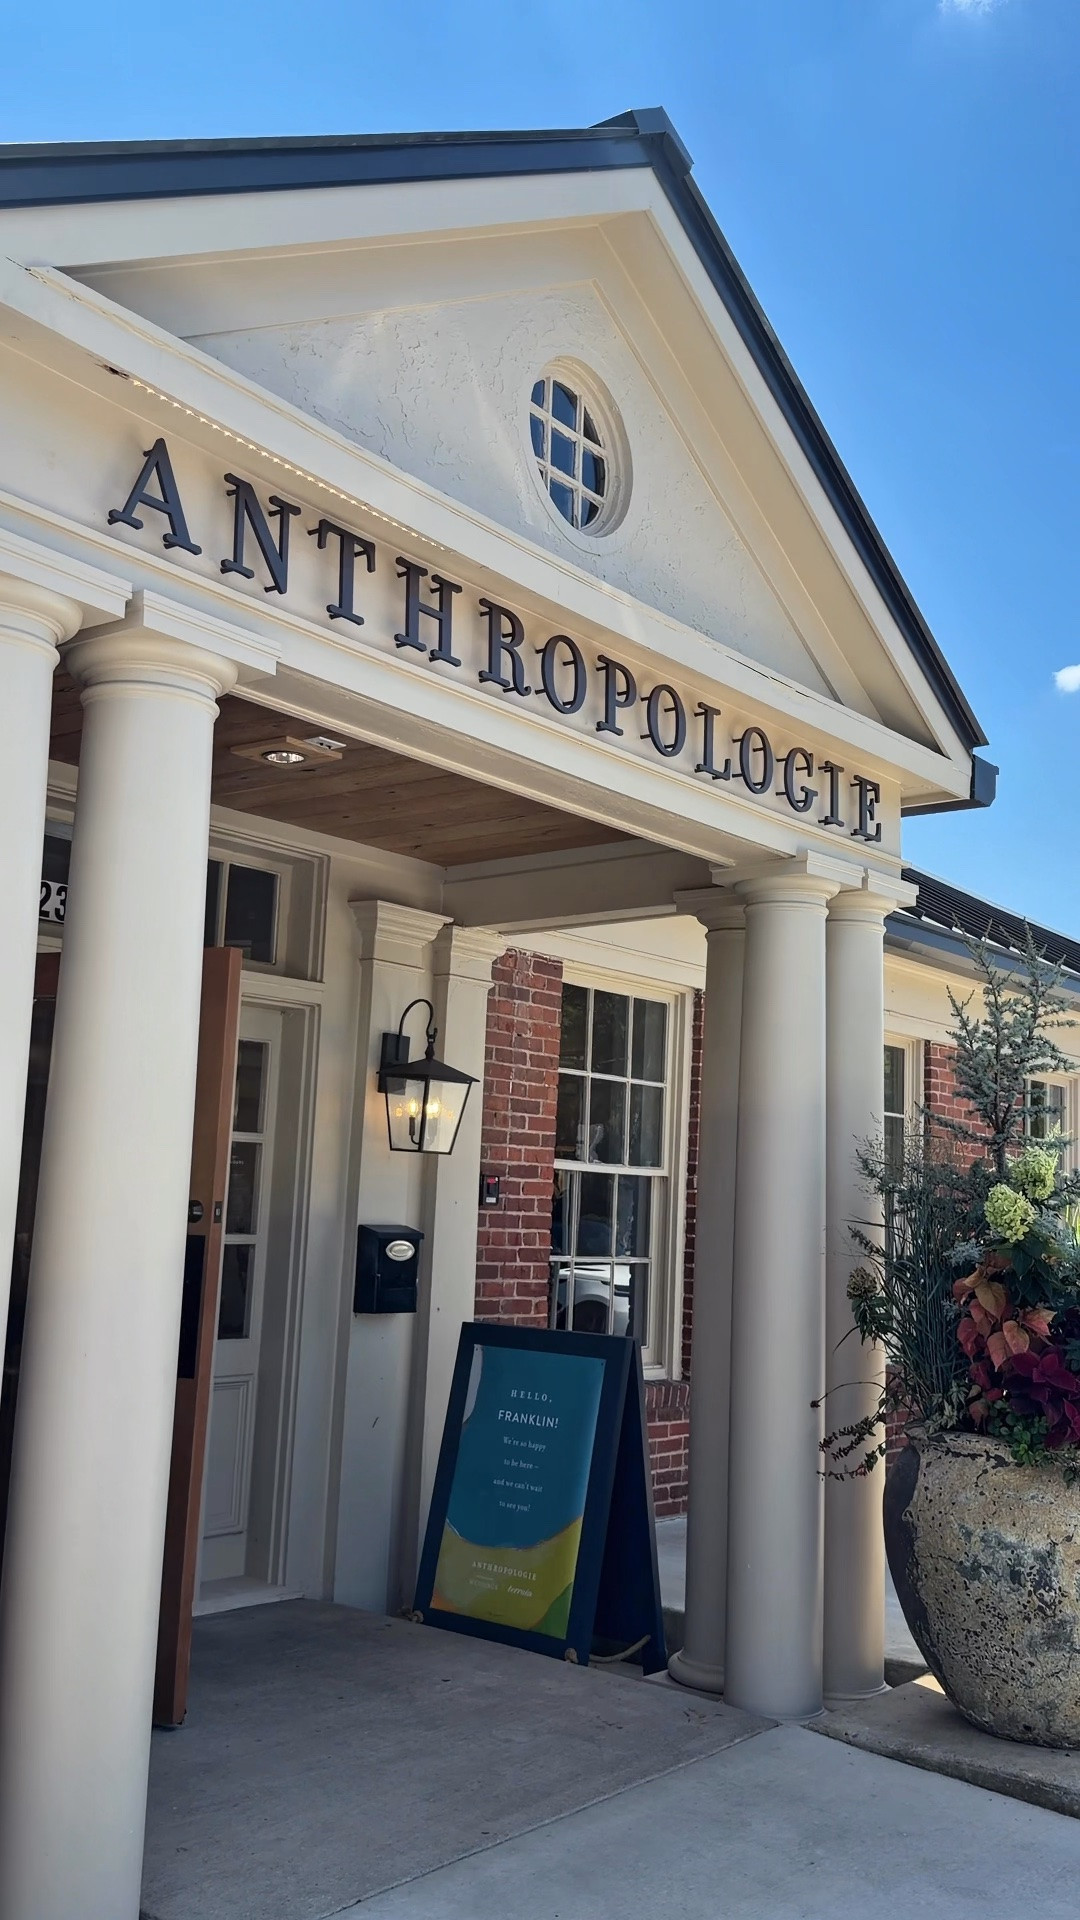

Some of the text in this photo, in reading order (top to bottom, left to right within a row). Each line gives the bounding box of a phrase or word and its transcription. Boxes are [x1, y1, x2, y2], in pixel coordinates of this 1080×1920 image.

[107, 438, 882, 842] ANTHROPOLOGIE
[511, 1389, 552, 1403] HELLO,
[498, 1409, 559, 1429] FRANKLIN!
[503, 1436, 519, 1446] We're
[528, 1440, 546, 1452] happy
[511, 1458, 519, 1467] be
[519, 1459, 533, 1469] here
[493, 1478, 505, 1486] and
[514, 1481, 529, 1490] can't
[530, 1484, 543, 1493] wait
[506, 1502, 516, 1510] see
[472, 1560, 536, 1581] ANTHROPOLOGIE
